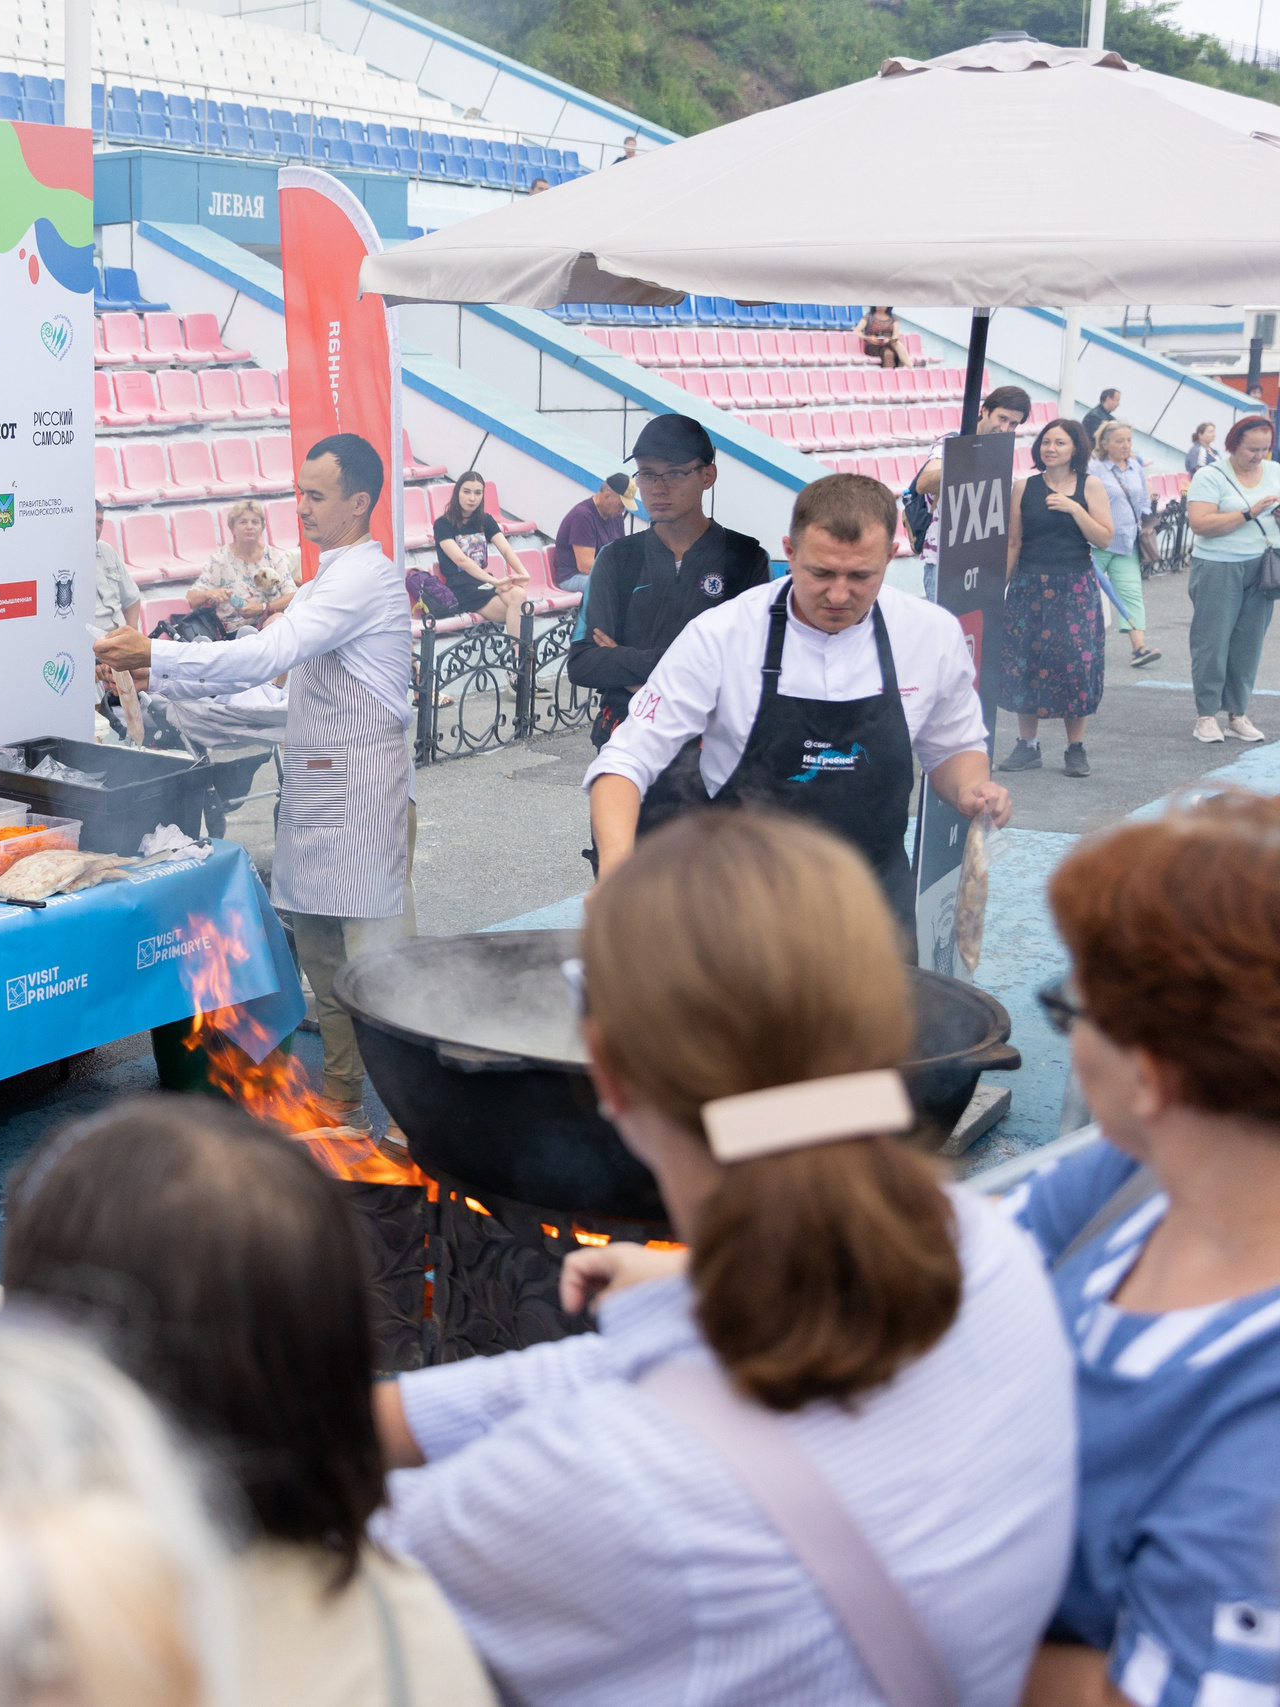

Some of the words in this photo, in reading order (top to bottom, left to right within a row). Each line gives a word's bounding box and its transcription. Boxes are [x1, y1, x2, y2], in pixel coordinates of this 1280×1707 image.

[208, 192, 264, 219] ЛЕВАЯ
[33, 408, 73, 426] РУССКИЙ
[33, 430, 74, 446] САМОВАР
[19, 499, 62, 509] ПРАВИТЕЛЬСТВО
[19, 508, 58, 517] ПРИМОРСКОГО
[59, 506, 74, 515] КРАЯ
[948, 478, 1005, 547] УХА
[964, 567, 979, 591] ОТ
[156, 928, 182, 948] VISIT
[155, 936, 211, 963] PRIMORYE
[27, 966, 60, 987] VISIT
[27, 973, 88, 1004] PRIMORYE
